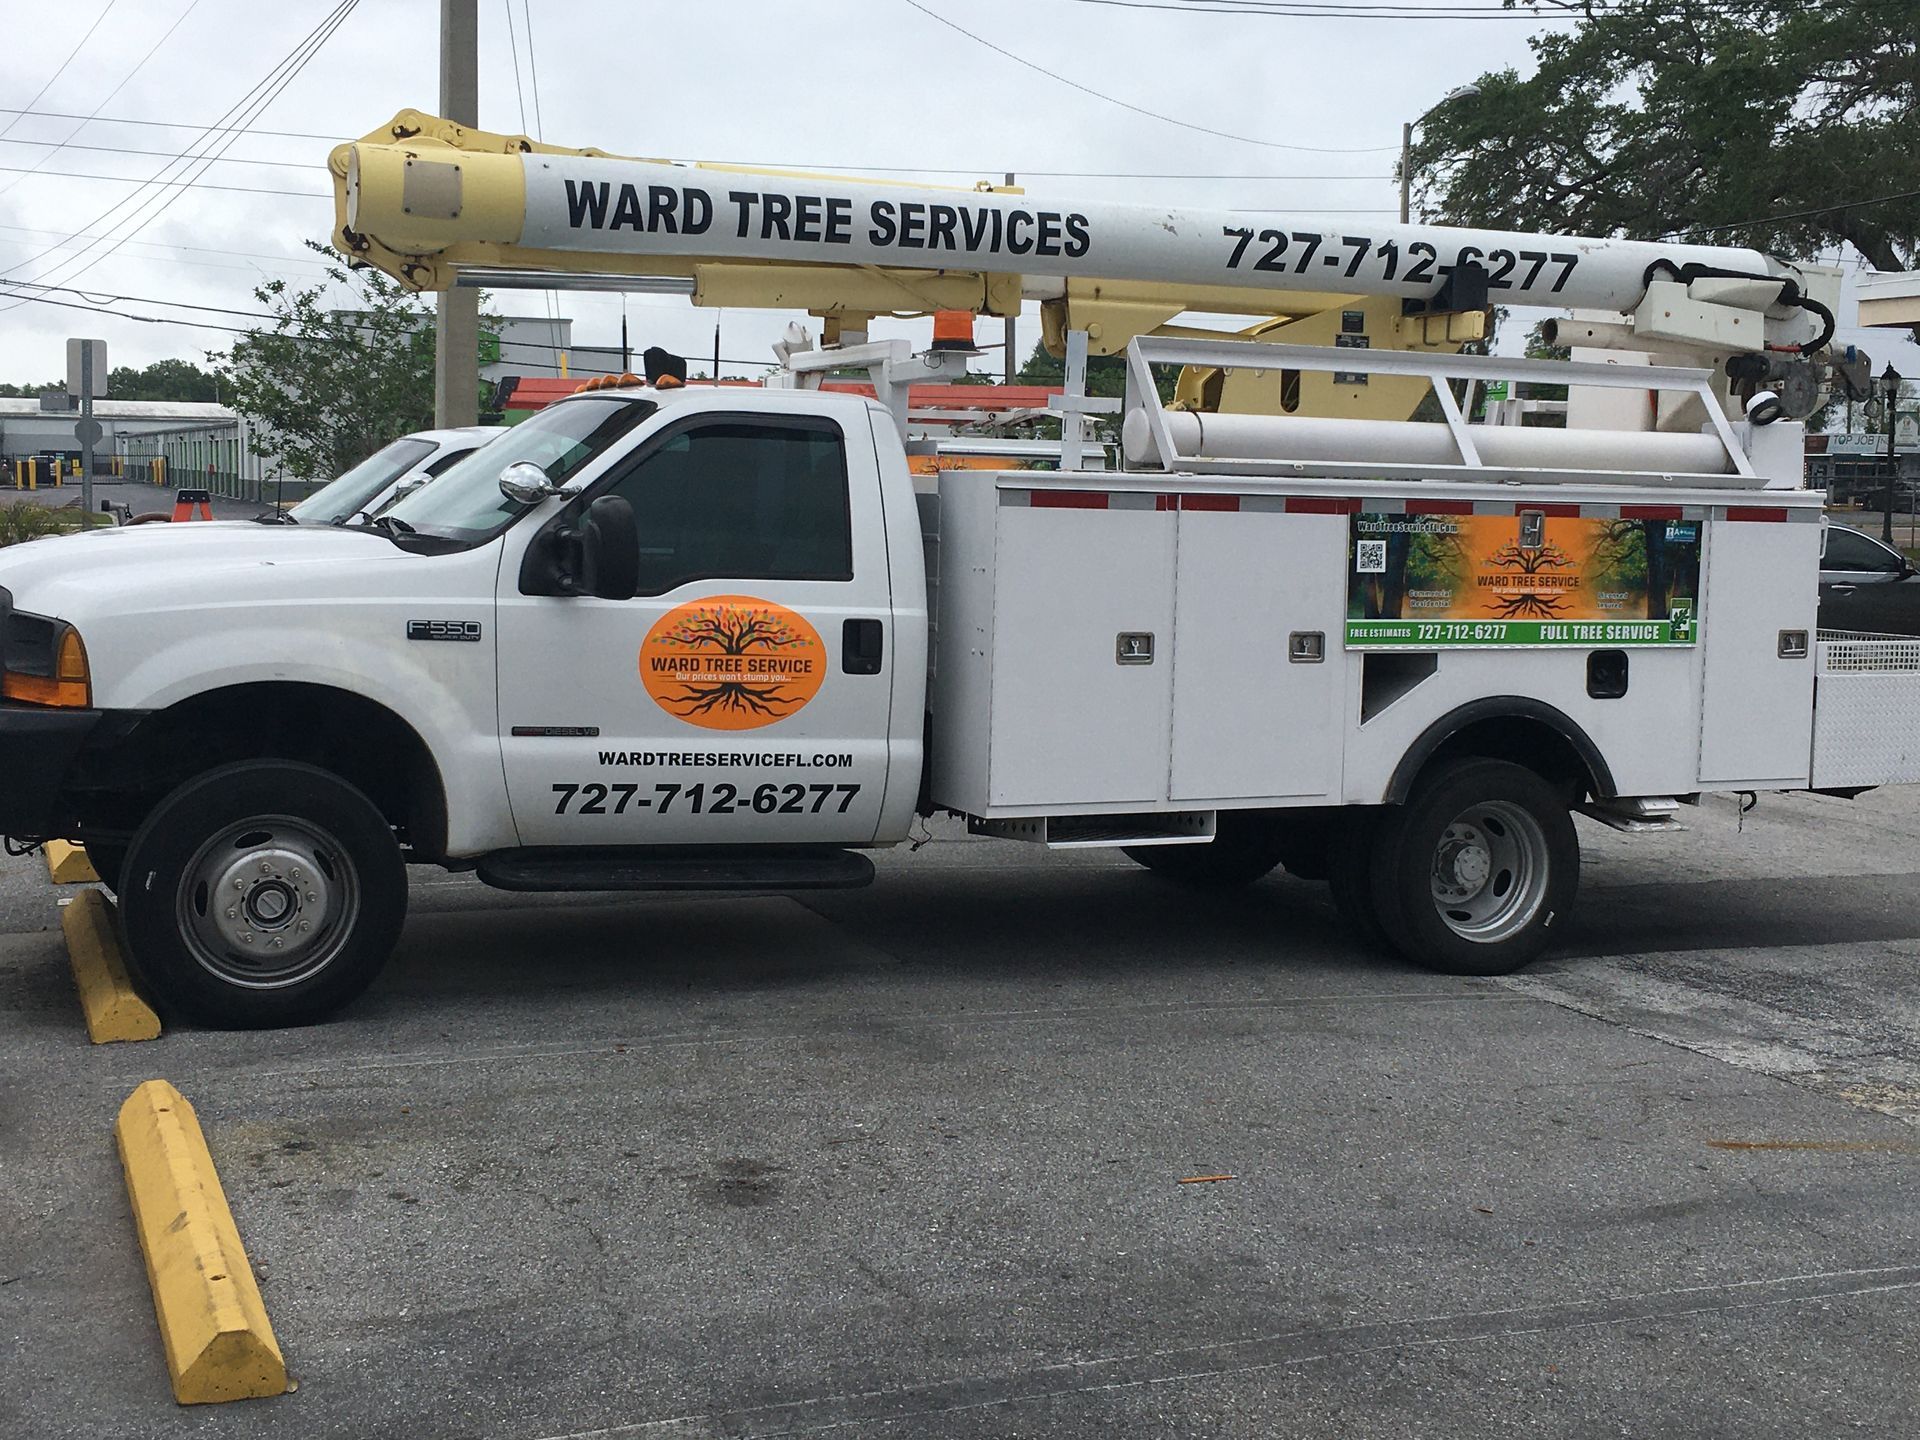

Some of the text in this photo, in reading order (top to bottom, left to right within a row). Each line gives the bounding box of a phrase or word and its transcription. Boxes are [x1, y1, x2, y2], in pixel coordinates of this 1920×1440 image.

[564, 179, 1092, 258] WARD TREE SERVICES
[1834, 435, 1852, 445] TOP
[1855, 435, 1874, 445] JOB
[1477, 575, 1580, 587] WARD TREE SERVICE
[1350, 628, 1367, 638] FREE
[1369, 628, 1411, 638] ESTIMATES
[1417, 624, 1507, 640] 727-712-6277
[1539, 624, 1569, 640] FULL
[1573, 624, 1603, 640] TREE
[1606, 624, 1660, 640] SERVICE
[651, 657, 813, 673] WARD TREE SERVICE
[675, 672, 690, 681] Our
[692, 672, 717, 683] prices
[743, 673, 769, 683] stump
[598, 750, 853, 768] WARDTREESERVICEFL.COM
[551, 783, 861, 815] 727-712-6277
